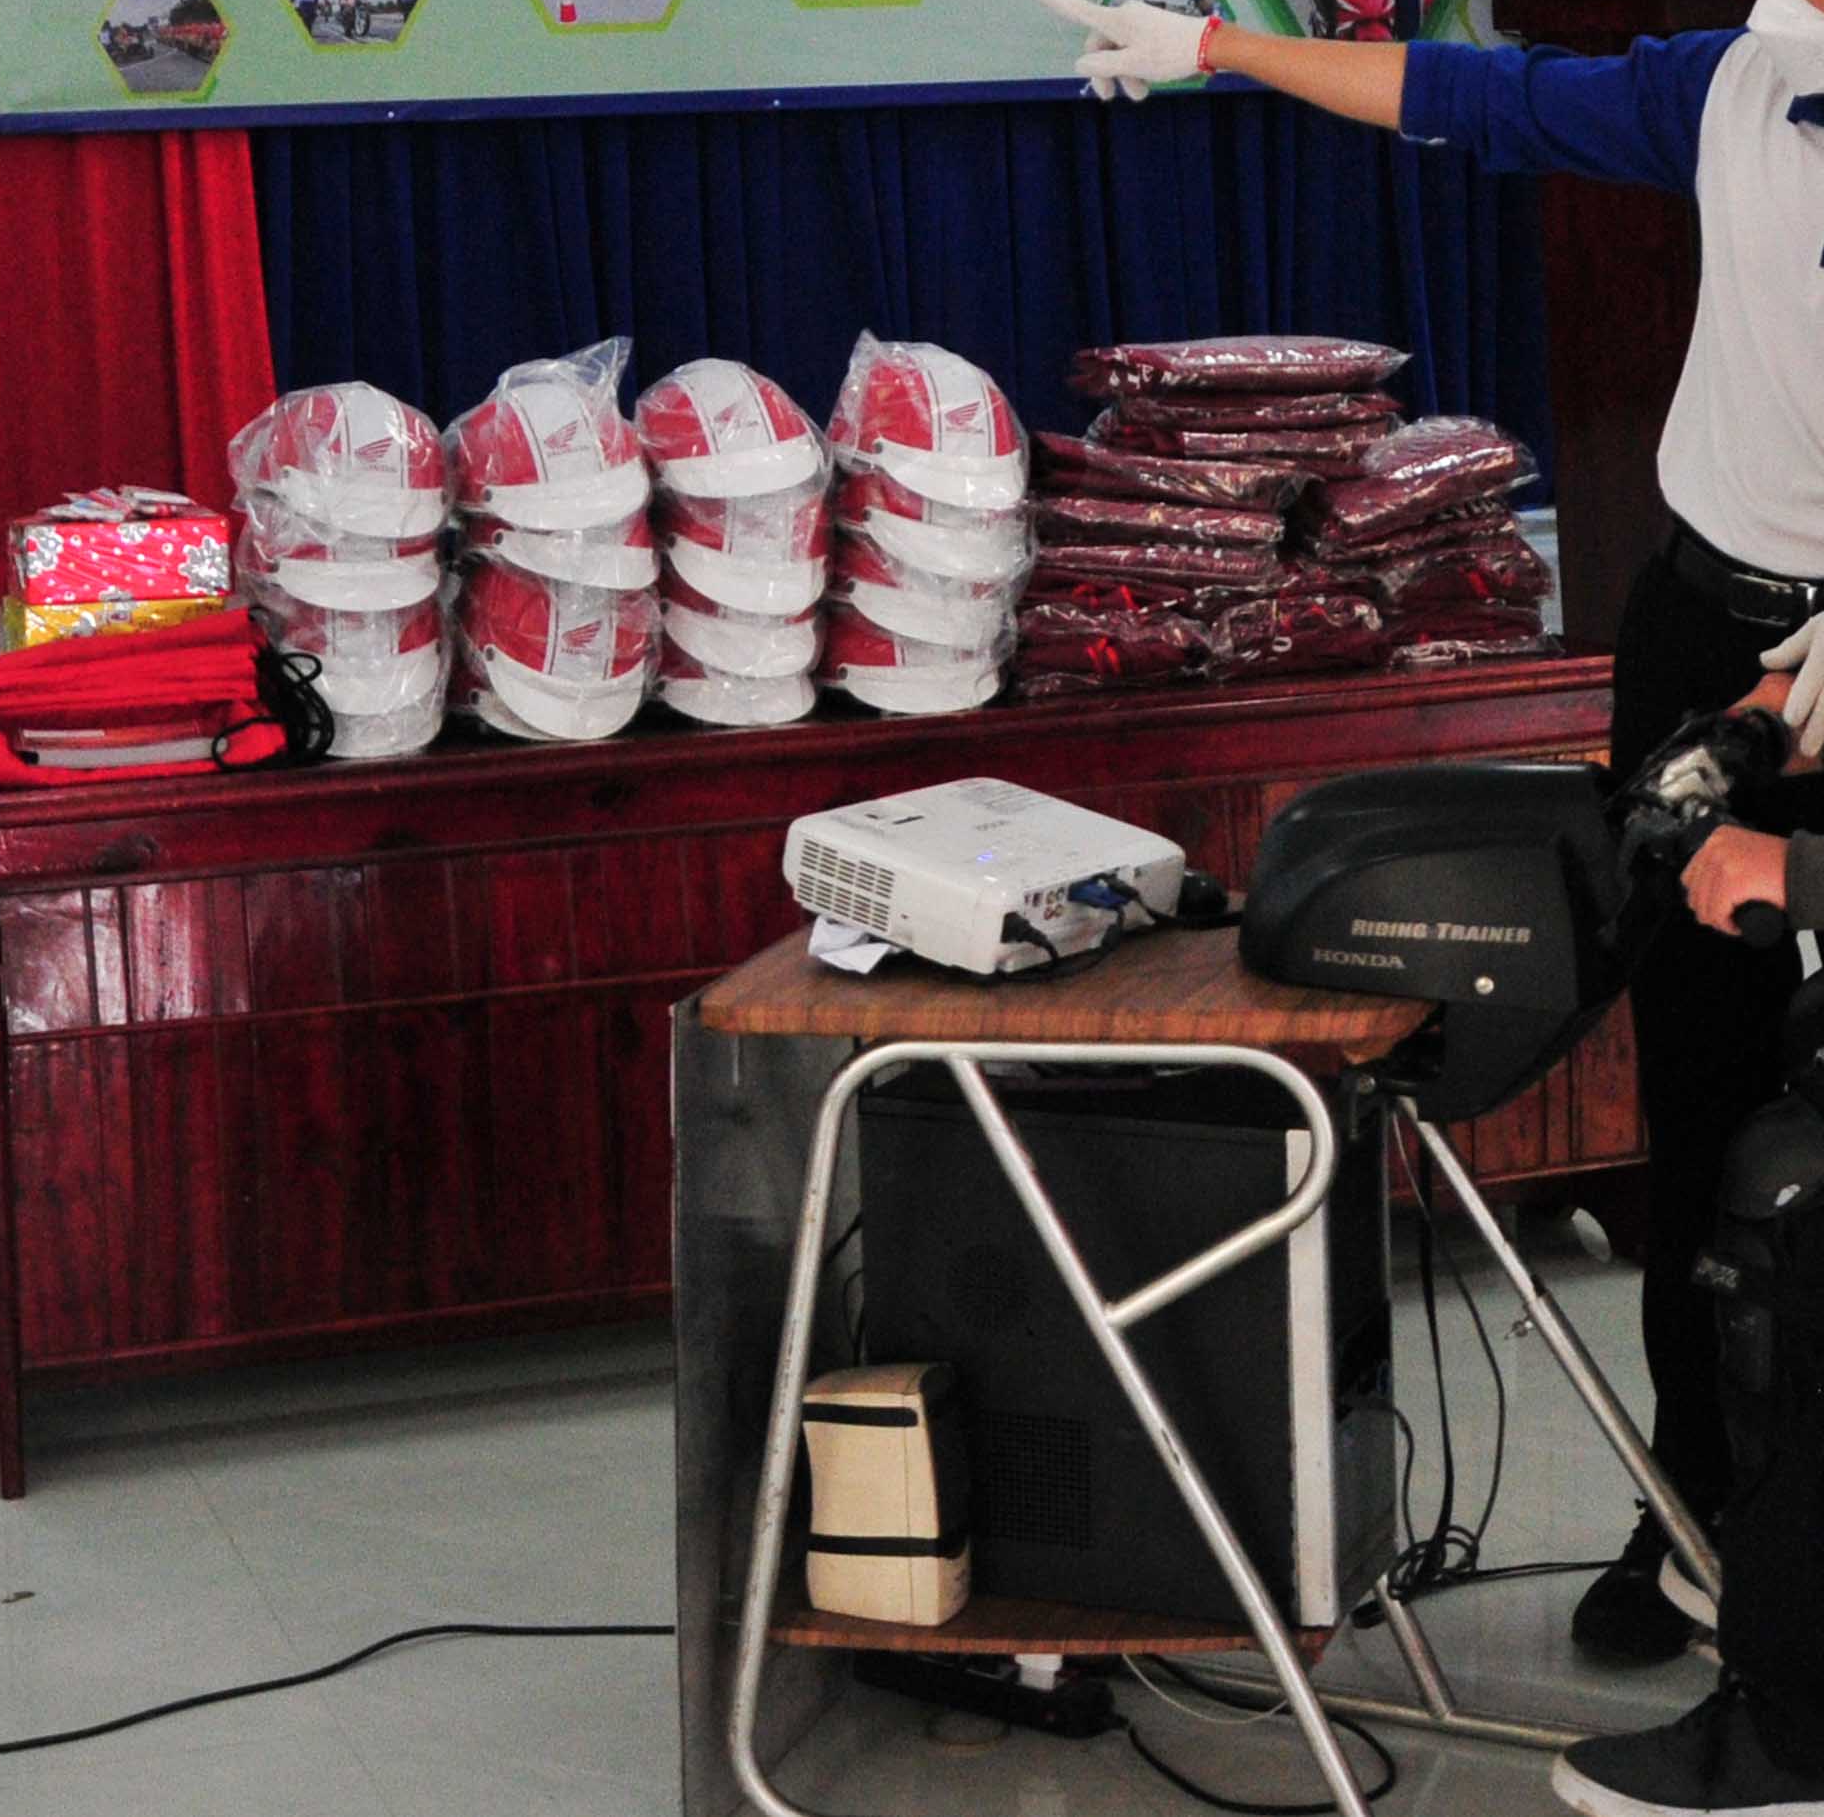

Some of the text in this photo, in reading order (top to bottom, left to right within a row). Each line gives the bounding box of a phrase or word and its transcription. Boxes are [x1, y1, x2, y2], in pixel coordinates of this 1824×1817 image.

[1351, 919, 1532, 943] RIDING TRAINER
[1313, 948, 1406, 970] HONDA
